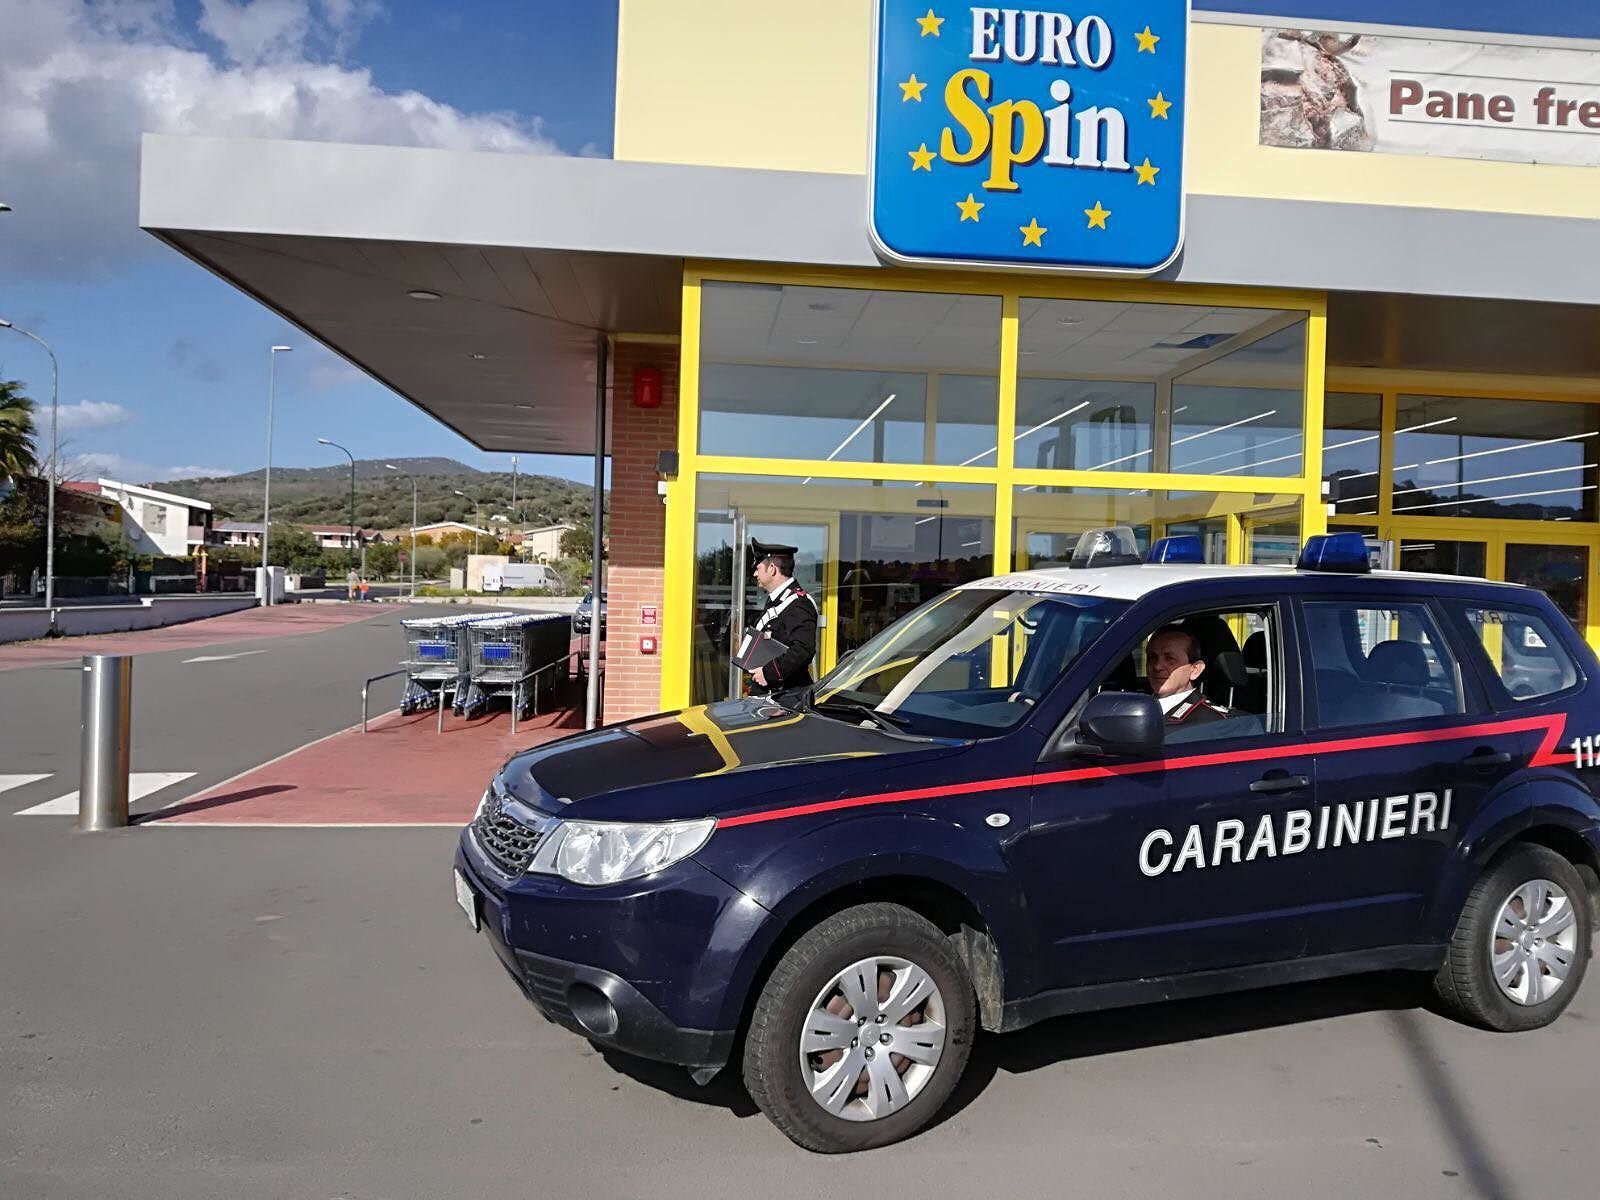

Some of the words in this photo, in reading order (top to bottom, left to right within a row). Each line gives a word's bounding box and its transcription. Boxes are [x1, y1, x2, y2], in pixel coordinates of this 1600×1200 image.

[969, 6, 1113, 69] EURO
[940, 68, 1131, 191] Spin
[1389, 78, 1516, 123] Pane
[1533, 86, 1600, 129] fre
[1138, 788, 1453, 877] CARABINIERI
